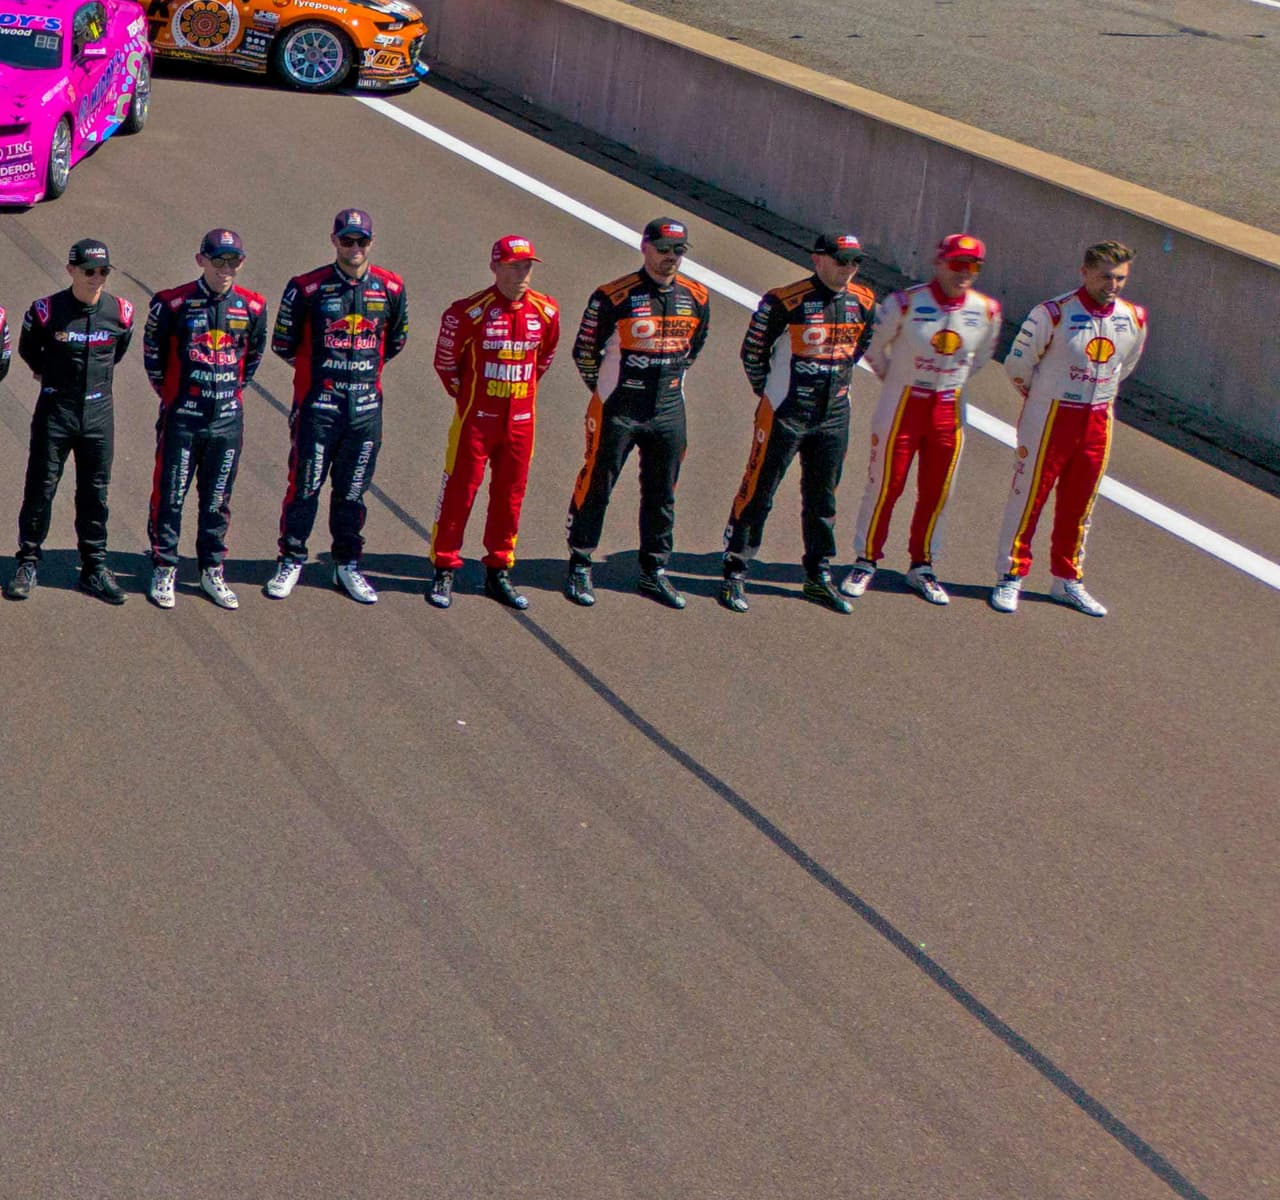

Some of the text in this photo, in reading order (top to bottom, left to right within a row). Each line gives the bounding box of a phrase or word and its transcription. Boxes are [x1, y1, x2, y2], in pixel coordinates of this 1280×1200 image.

[375, 53, 400, 67] BIC
[6, 142, 33, 155] TRG
[656, 319, 691, 330] TRUCK
[67, 331, 109, 343] PremiAir
[324, 334, 351, 349] Red
[190, 348, 214, 364] Red
[321, 358, 374, 371] AMPOL
[190, 370, 237, 382] AMPOL
[484, 362, 522, 381] MAKE
[486, 380, 529, 399] SUPER
